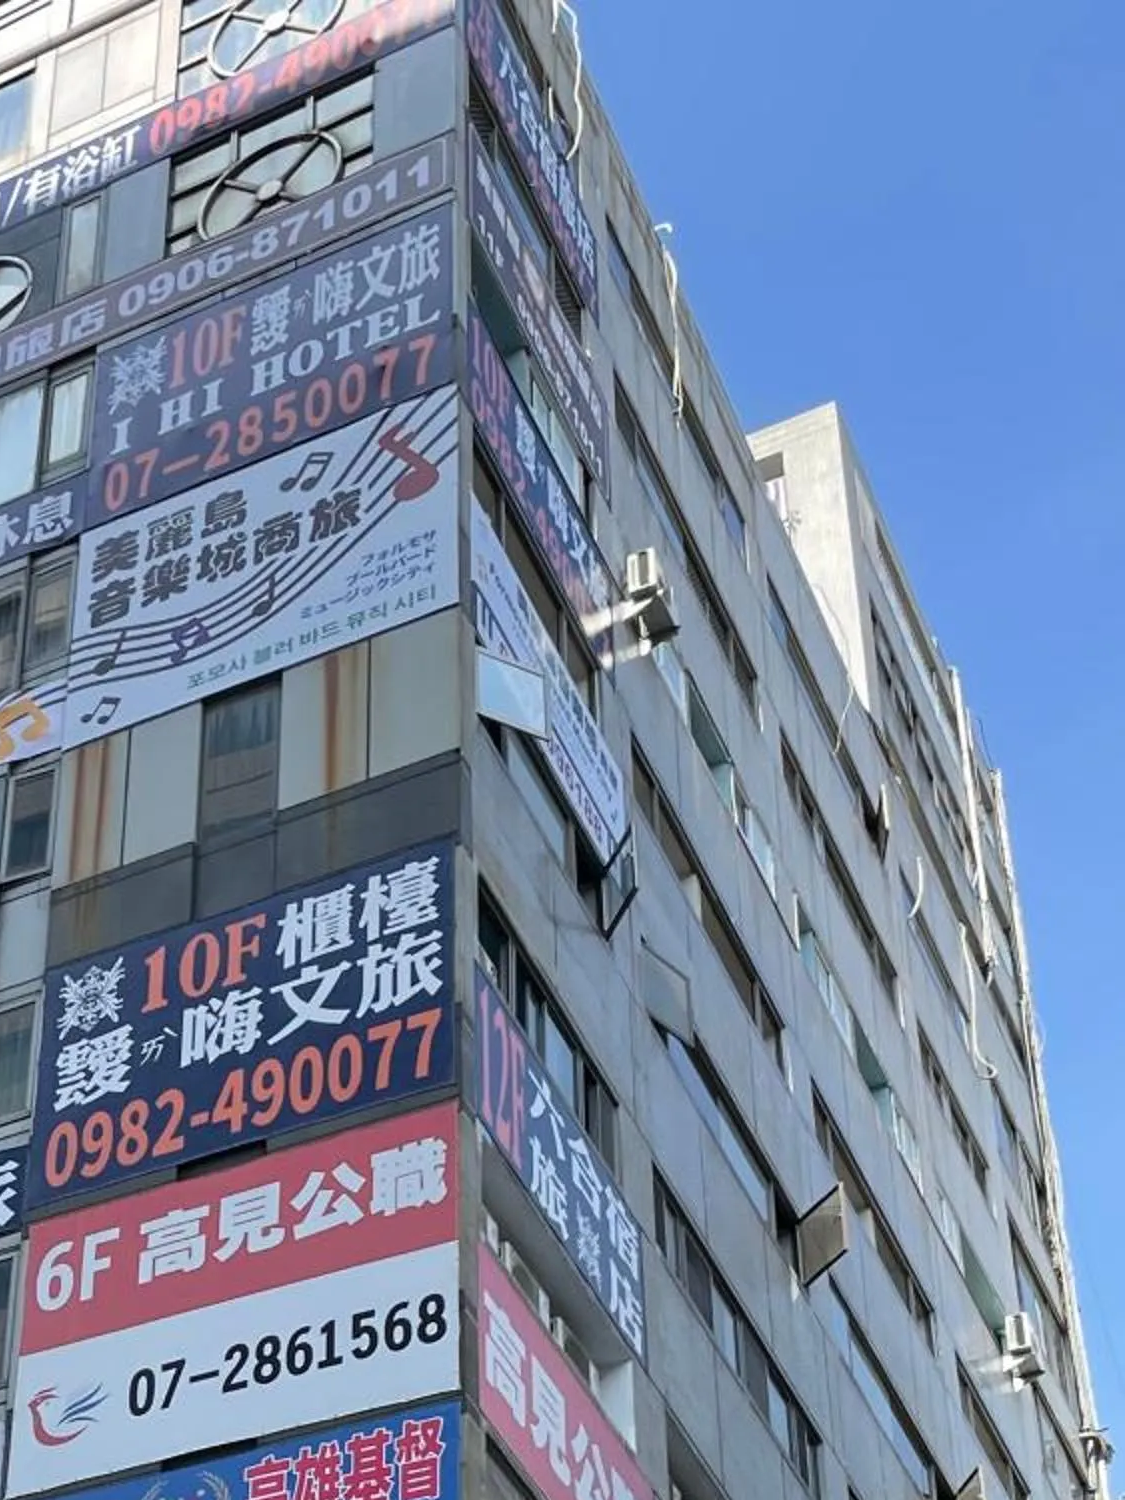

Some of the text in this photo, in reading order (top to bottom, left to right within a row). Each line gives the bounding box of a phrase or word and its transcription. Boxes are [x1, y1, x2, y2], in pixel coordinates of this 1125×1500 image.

[118, 156, 431, 317] 0906-871011
[110, 294, 441, 454] I HI HOTEL
[168, 305, 248, 391] 10F
[88, 488, 362, 628] 音樂城商旅
[91, 490, 248, 583] 美麗島
[141, 856, 441, 1014] 10F 櫃檯
[44, 1008, 443, 1187] 0982-490077
[480, 987, 526, 1173] 12F
[35, 1137, 450, 1311] 6F 高見公職
[127, 1293, 448, 1417] 07-2861568
